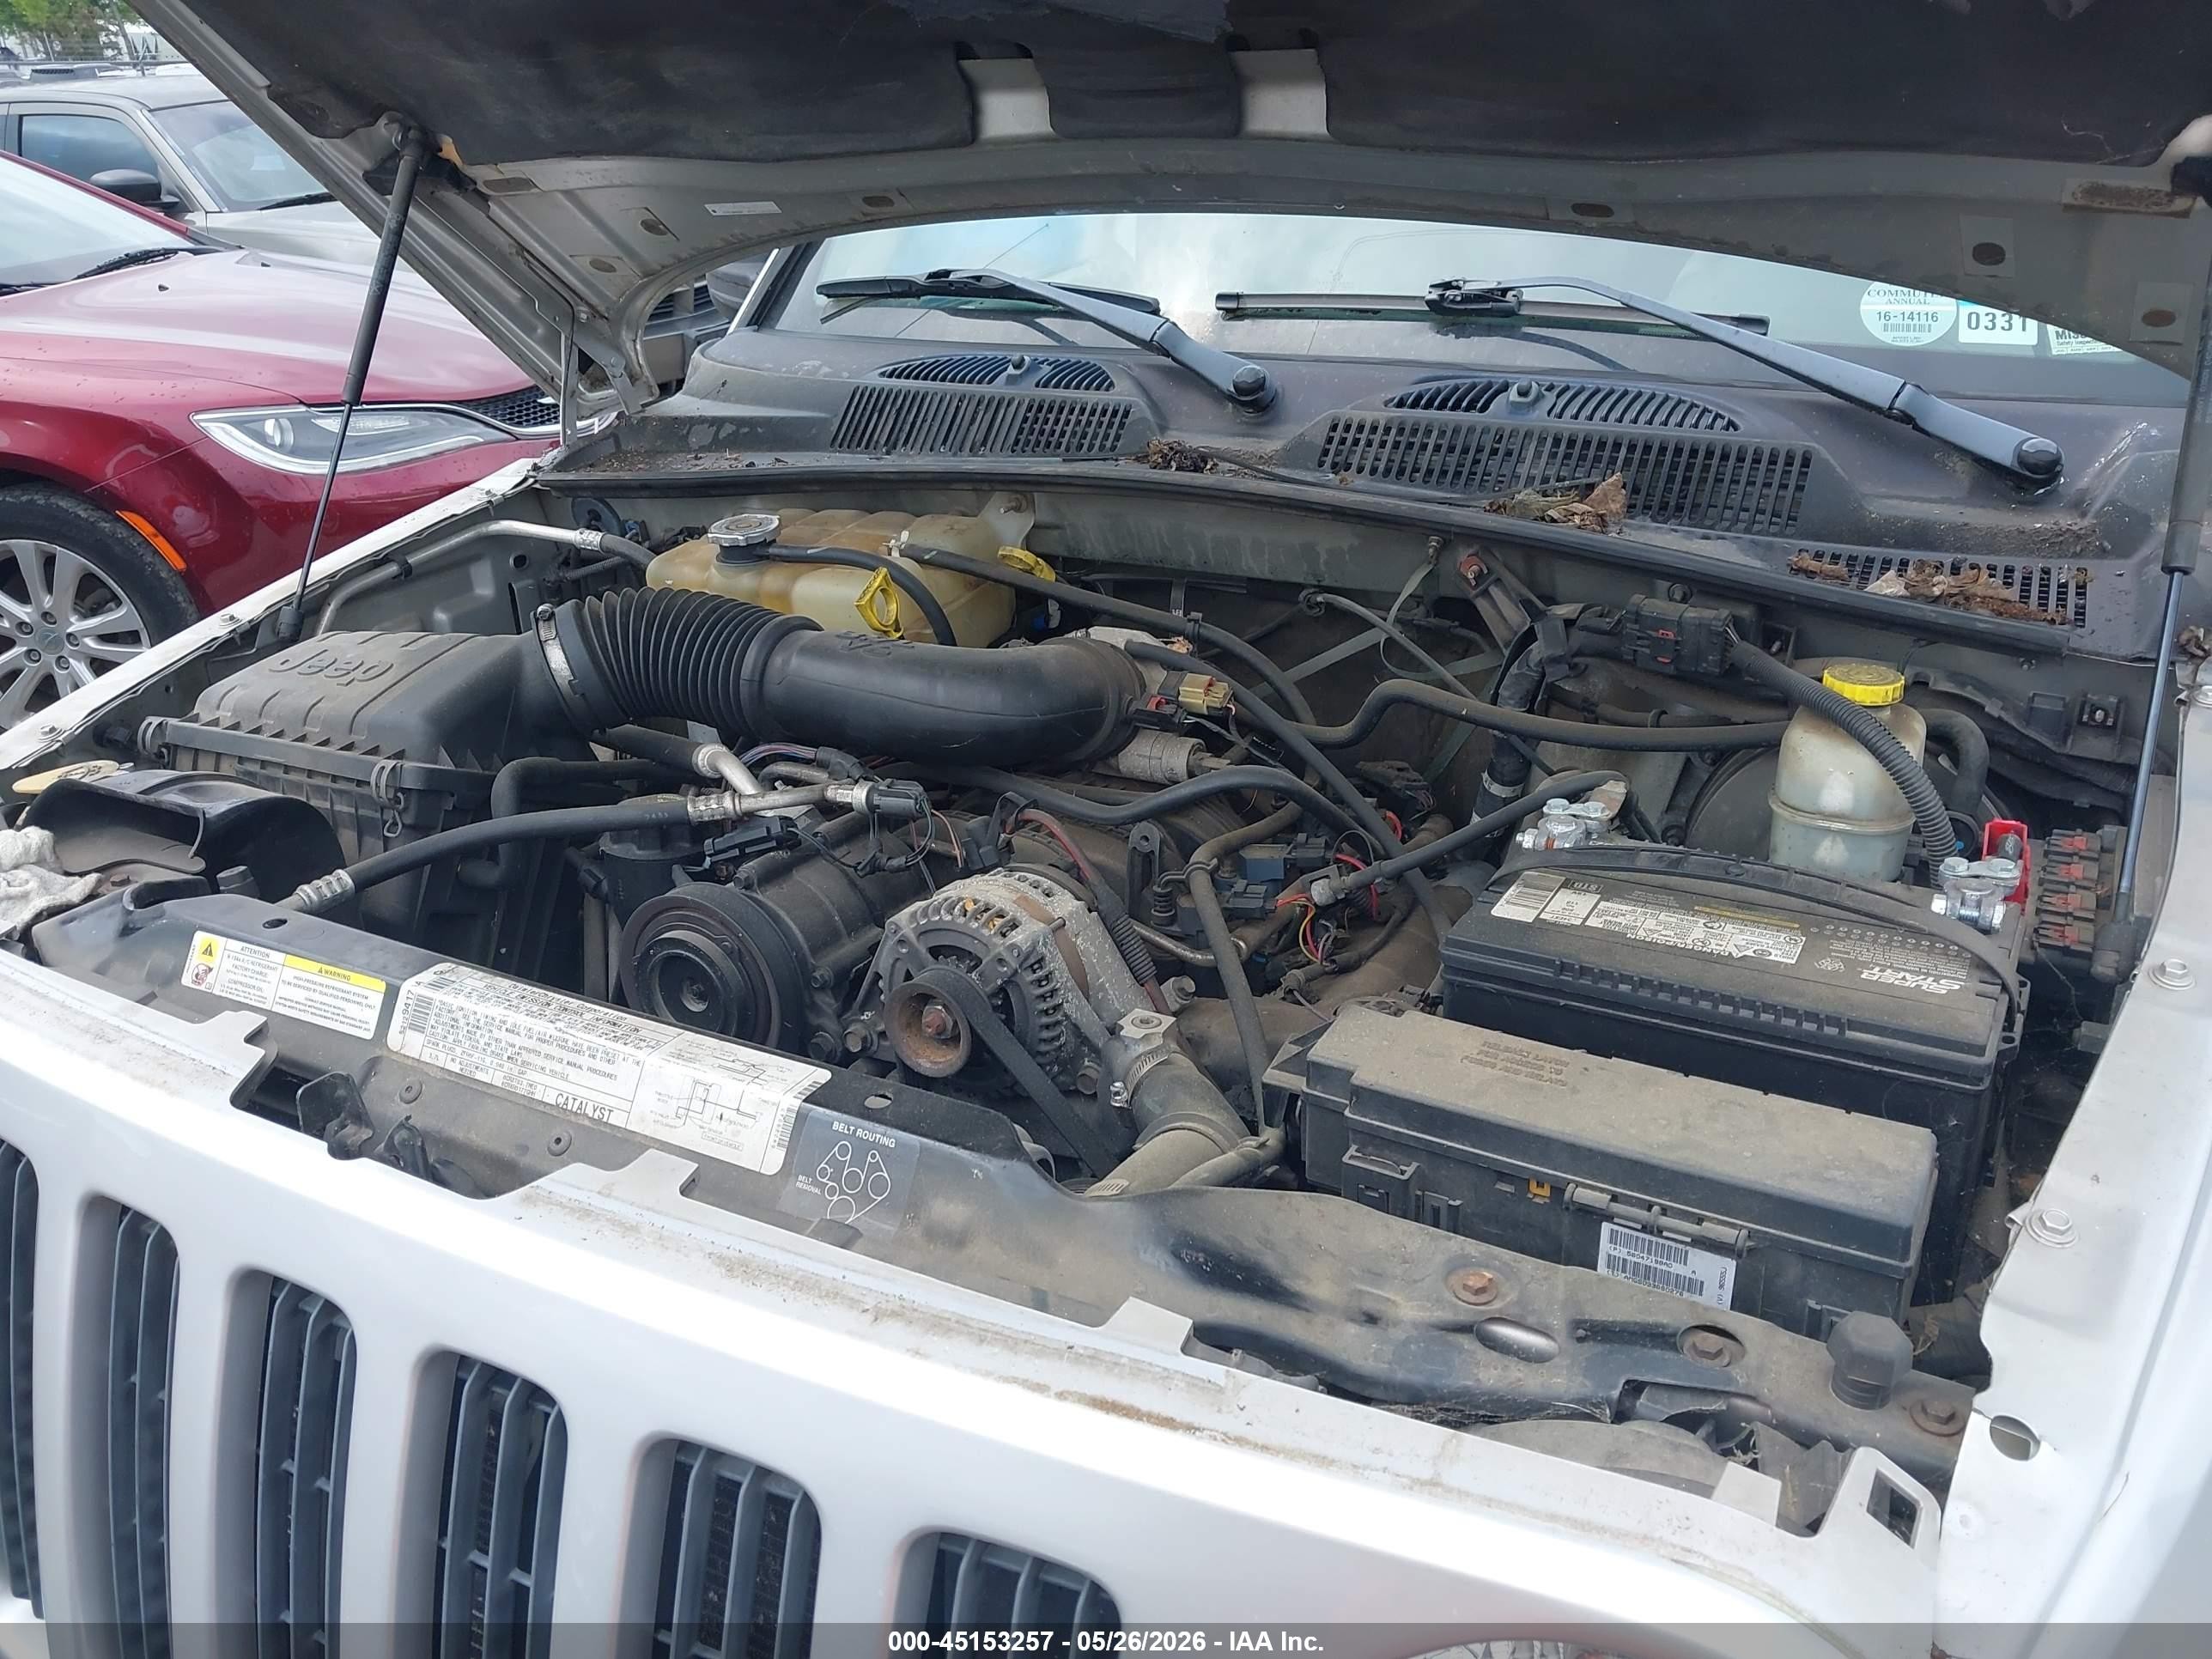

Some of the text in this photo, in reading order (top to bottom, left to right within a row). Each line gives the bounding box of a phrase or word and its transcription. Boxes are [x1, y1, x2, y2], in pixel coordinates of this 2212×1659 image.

[1876, 311, 1939, 322] 16-14116
[1967, 312, 2027, 332] 0331
[269, 649, 394, 687] Jeep
[240, 945, 270, 958] ATTENTION
[323, 968, 350, 981] WARNING
[1860, 971, 1948, 994] SUPER
[1862, 967, 1966, 990] START
[318, 989, 339, 1000] QUALIFIED
[339, 995, 363, 1006] PERSONNEL
[352, 992, 368, 1000] SYSTEM
[507, 982, 574, 1006] DaimlerChrysler
[575, 1003, 628, 1022] Corporation
[481, 983, 643, 1034] VEHICLE EMISSION CONTROL INFORMATION
[556, 1092, 614, 1123] CATALYST
[832, 1121, 896, 1148] BELT ROUTING
[795, 1182, 822, 1195] REMOVAL
[798, 1175, 812, 1184] BELT
